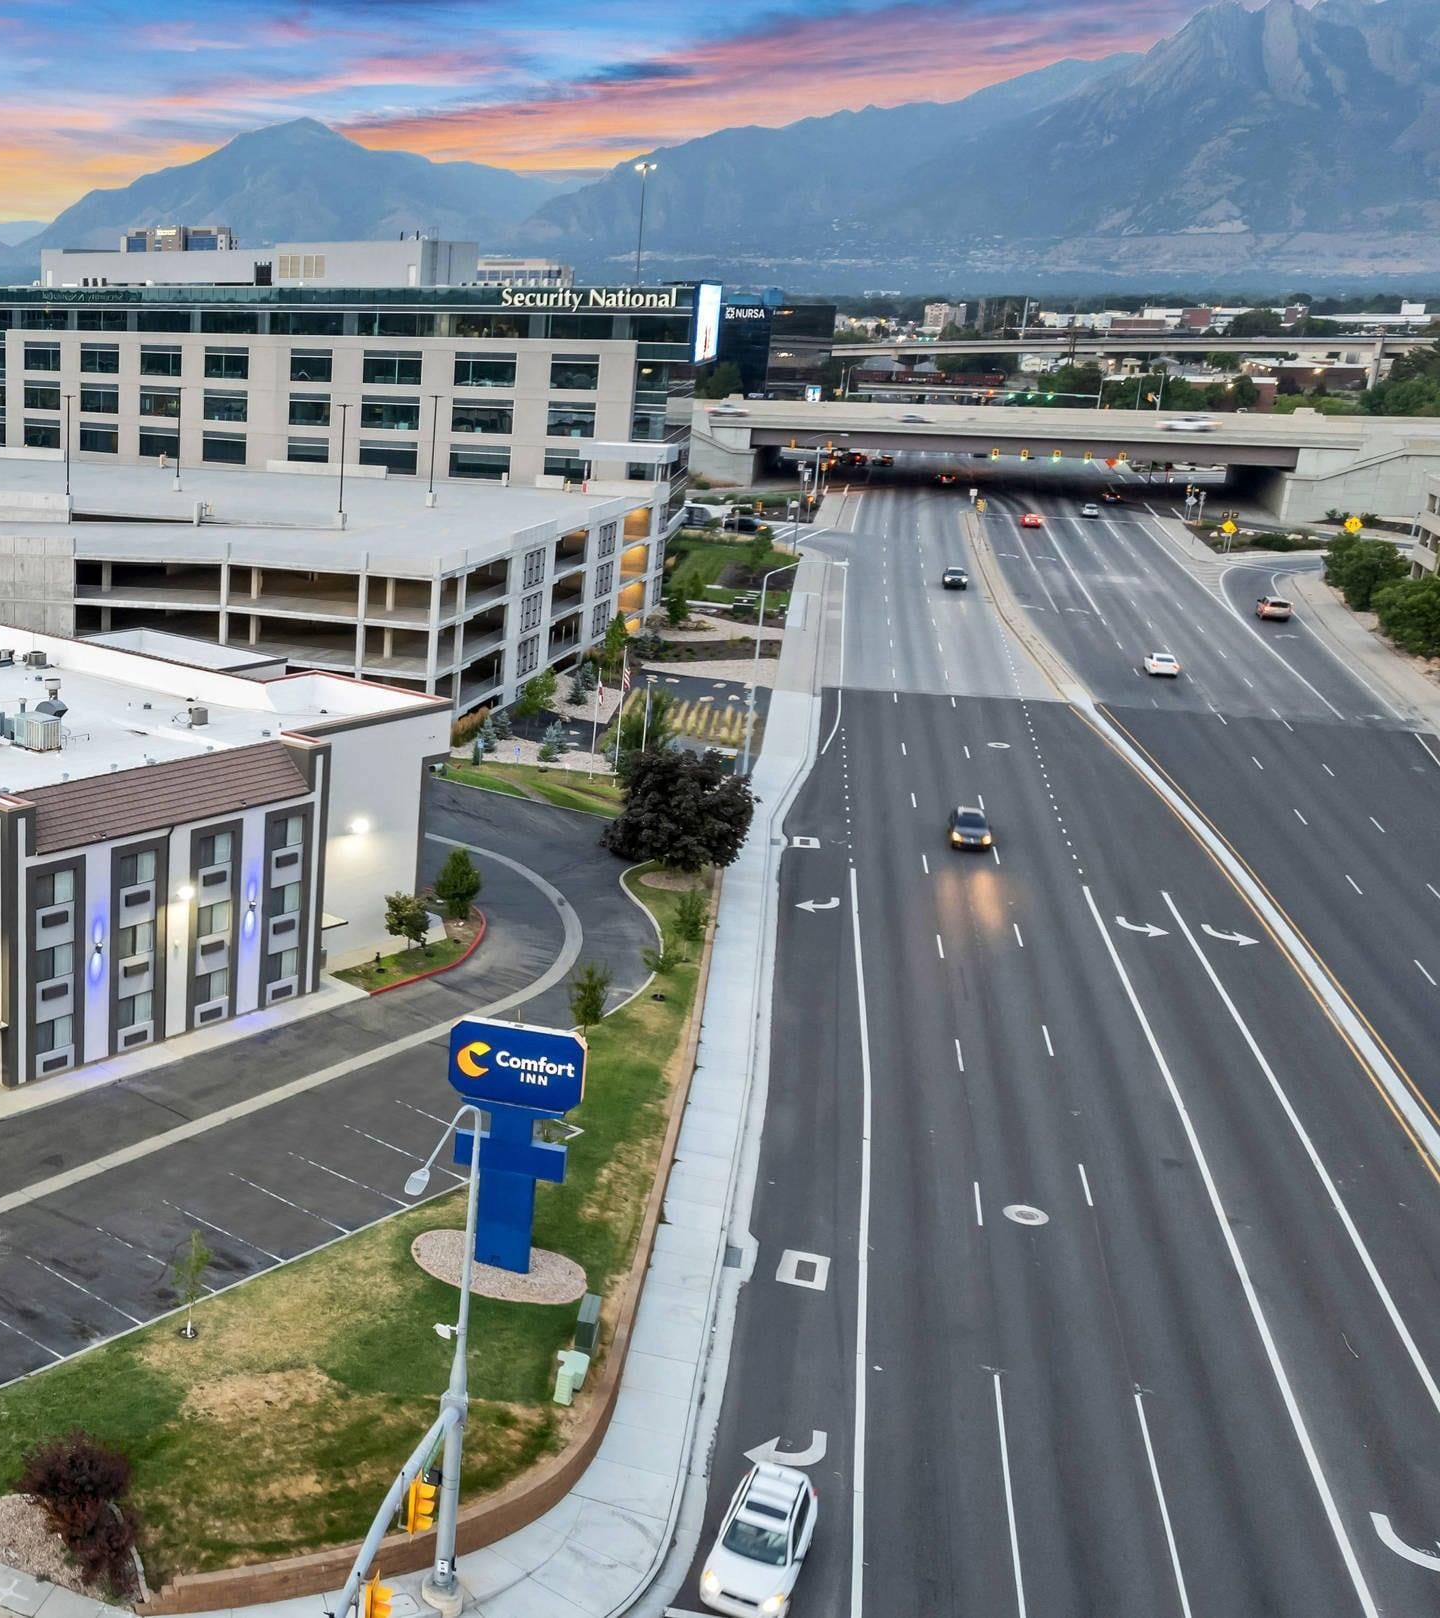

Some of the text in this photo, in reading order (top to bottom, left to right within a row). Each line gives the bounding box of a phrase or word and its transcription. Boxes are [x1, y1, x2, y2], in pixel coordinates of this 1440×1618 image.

[501, 287, 676, 312] Security National
[734, 308, 765, 319] NURSA
[495, 1050, 575, 1078] Comfort
[520, 1072, 548, 1087] INN
